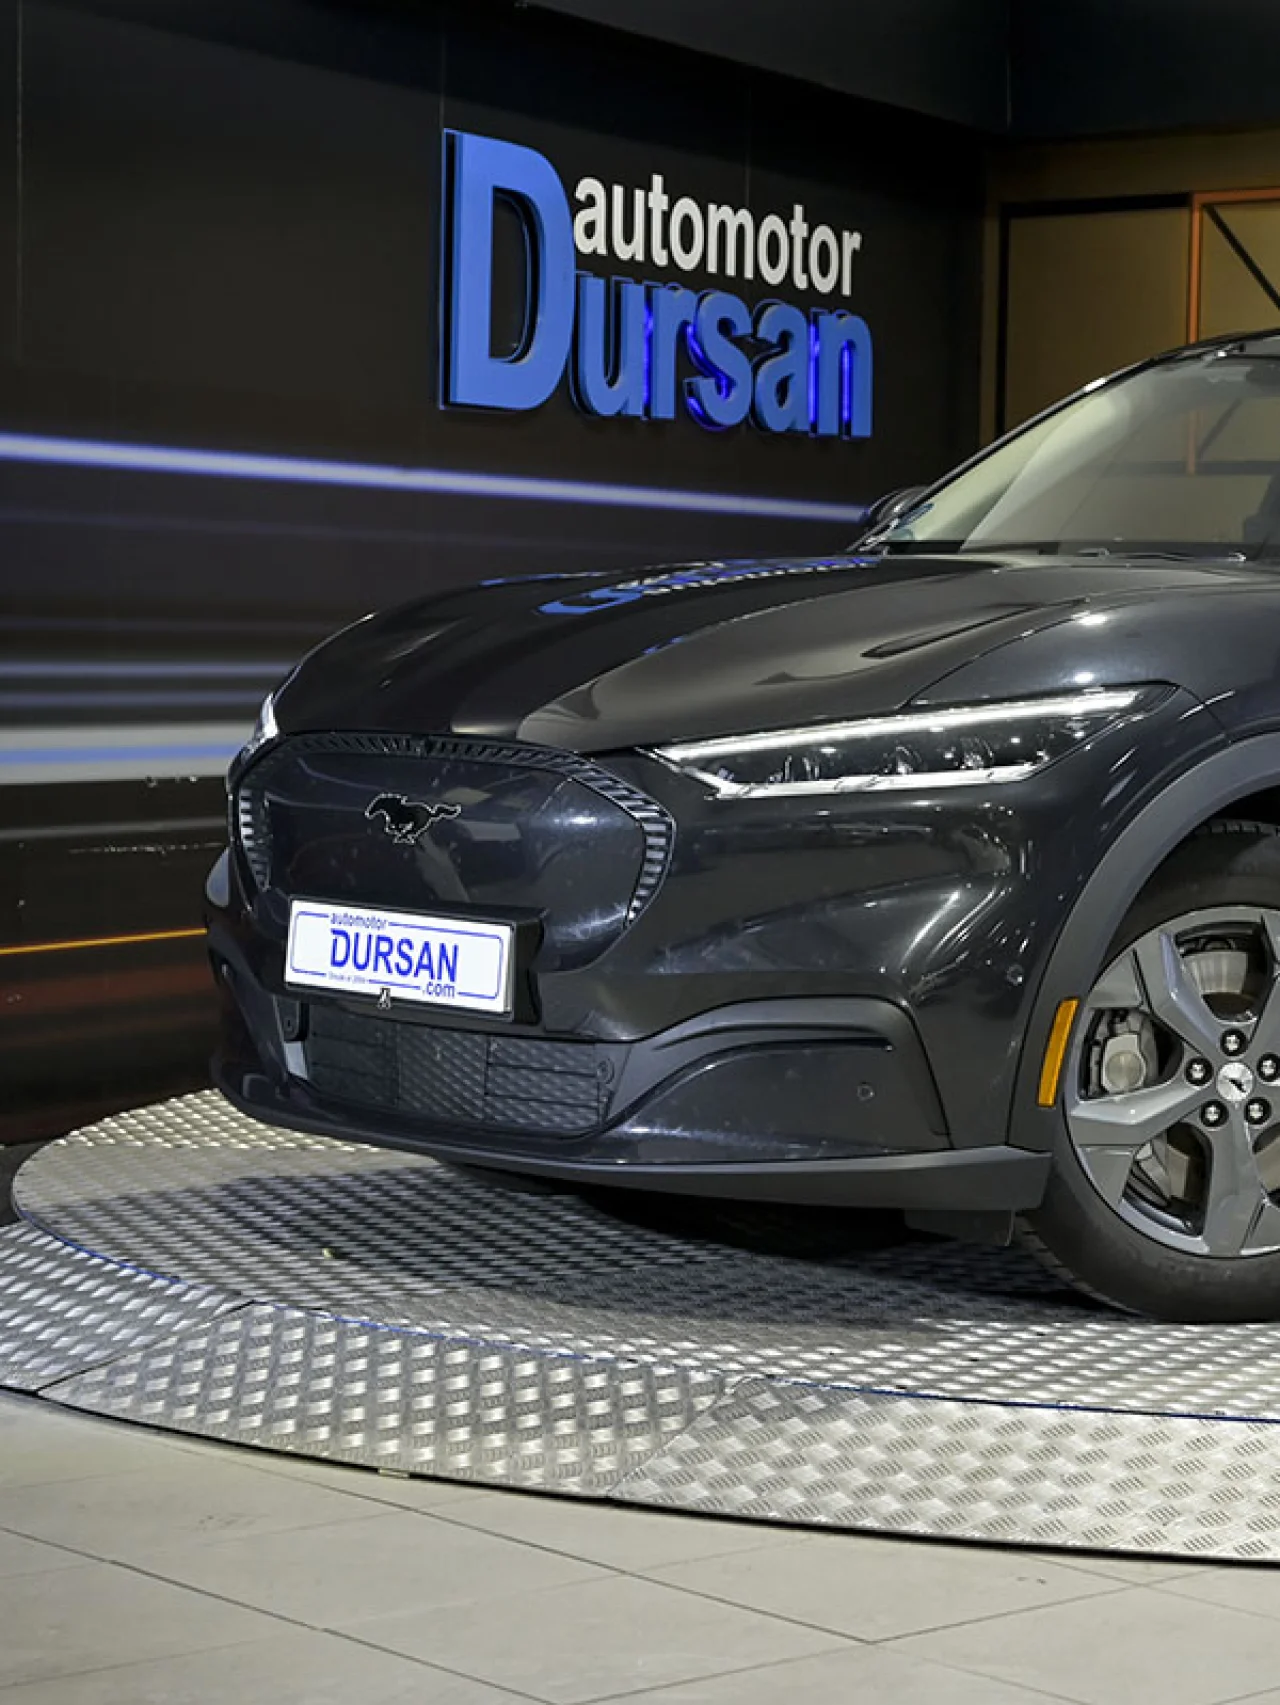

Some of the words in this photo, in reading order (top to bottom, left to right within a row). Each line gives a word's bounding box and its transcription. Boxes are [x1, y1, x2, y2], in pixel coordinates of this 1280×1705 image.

[573, 174, 862, 296] automotor
[440, 128, 873, 439] Dursan
[330, 912, 388, 930] automotor
[330, 927, 459, 982] DURSAN
[421, 981, 456, 998] .com
